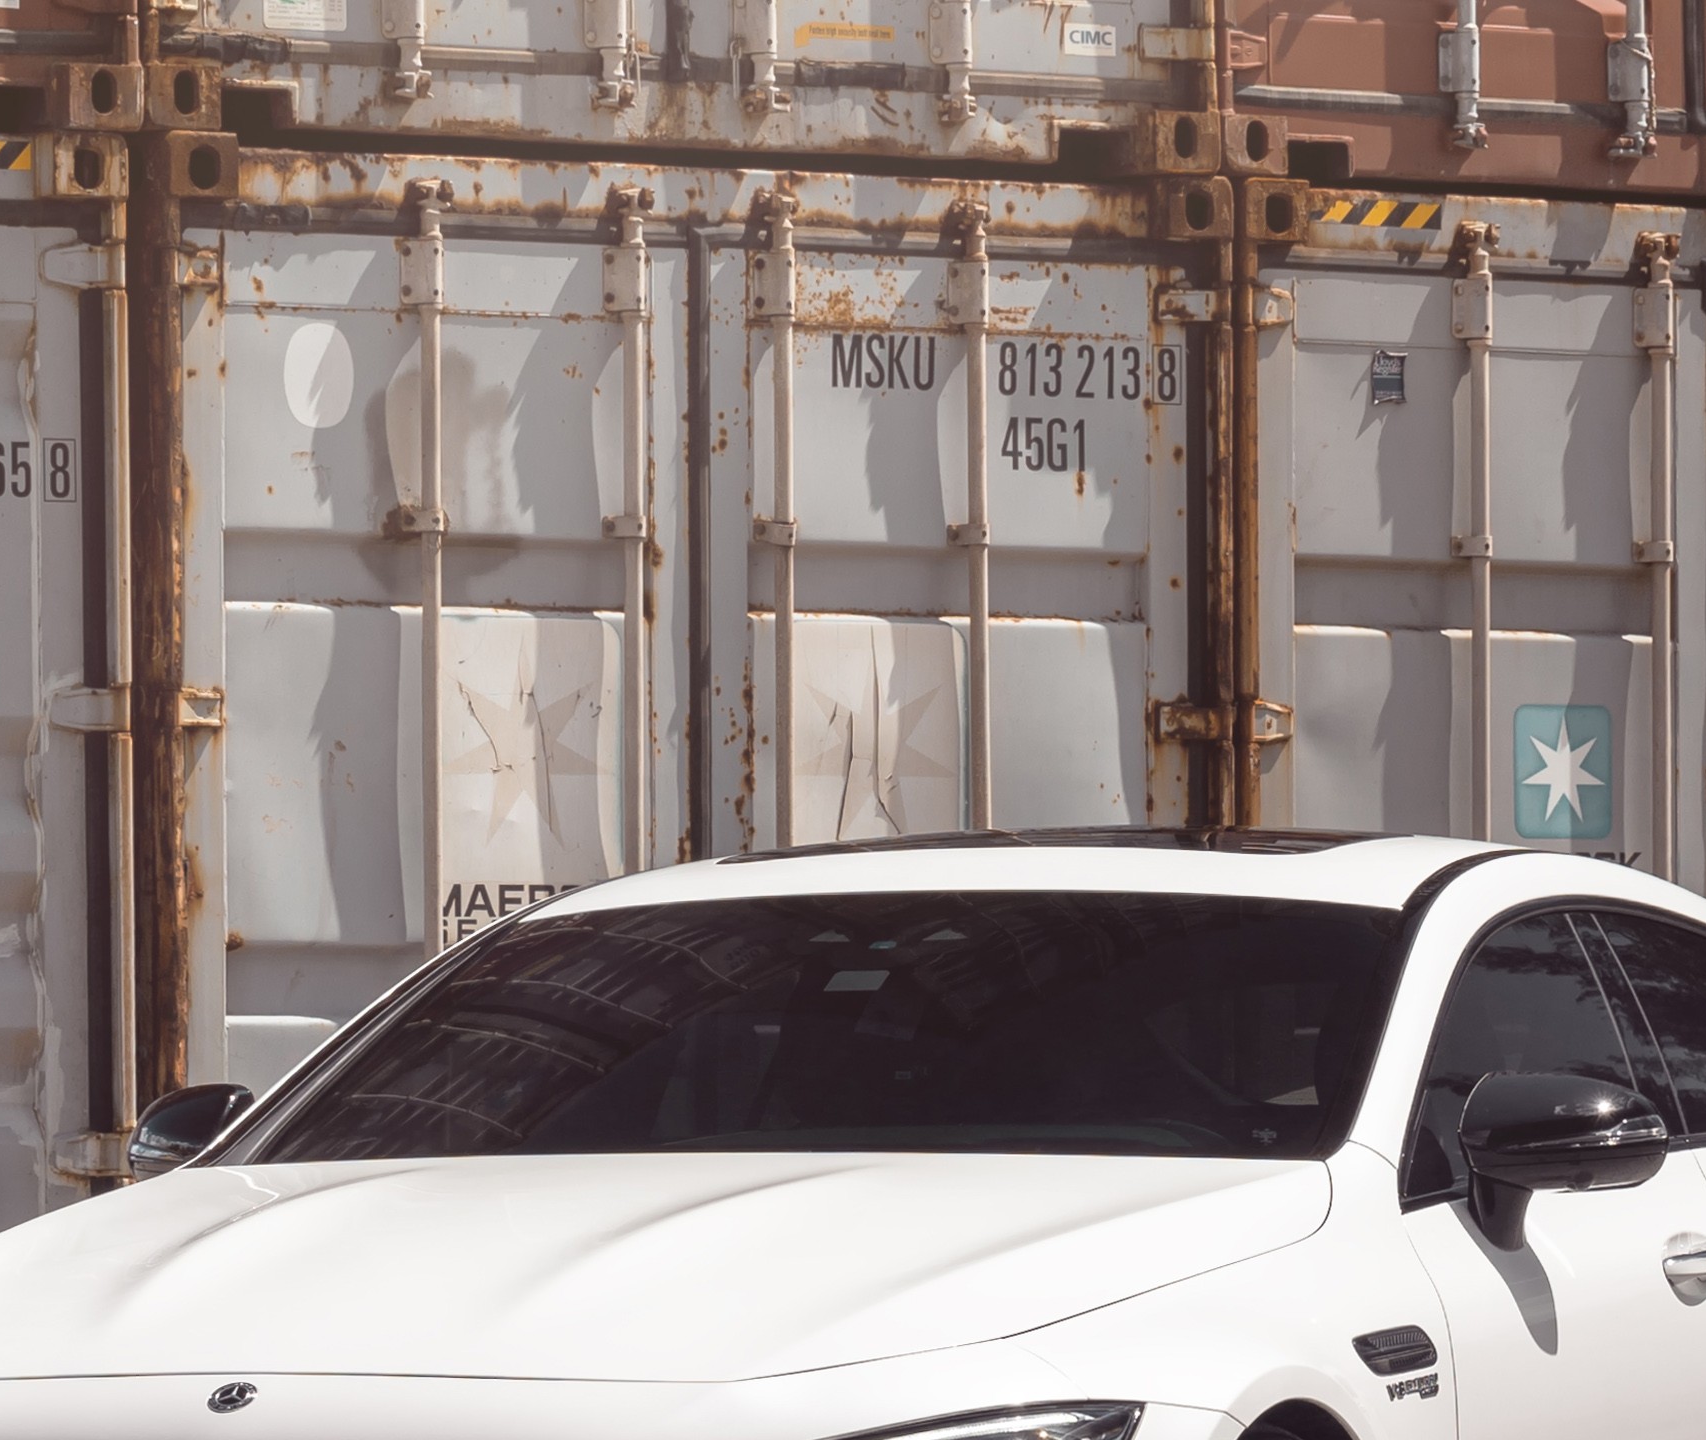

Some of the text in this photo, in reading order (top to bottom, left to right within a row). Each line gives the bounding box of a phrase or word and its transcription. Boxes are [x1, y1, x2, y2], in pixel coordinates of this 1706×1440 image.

[1069, 30, 1112, 46] CIMC
[831, 334, 1176, 402] MSKU 813 213 8
[49, 444, 71, 499] 8
[1001, 417, 1086, 472] 45G1
